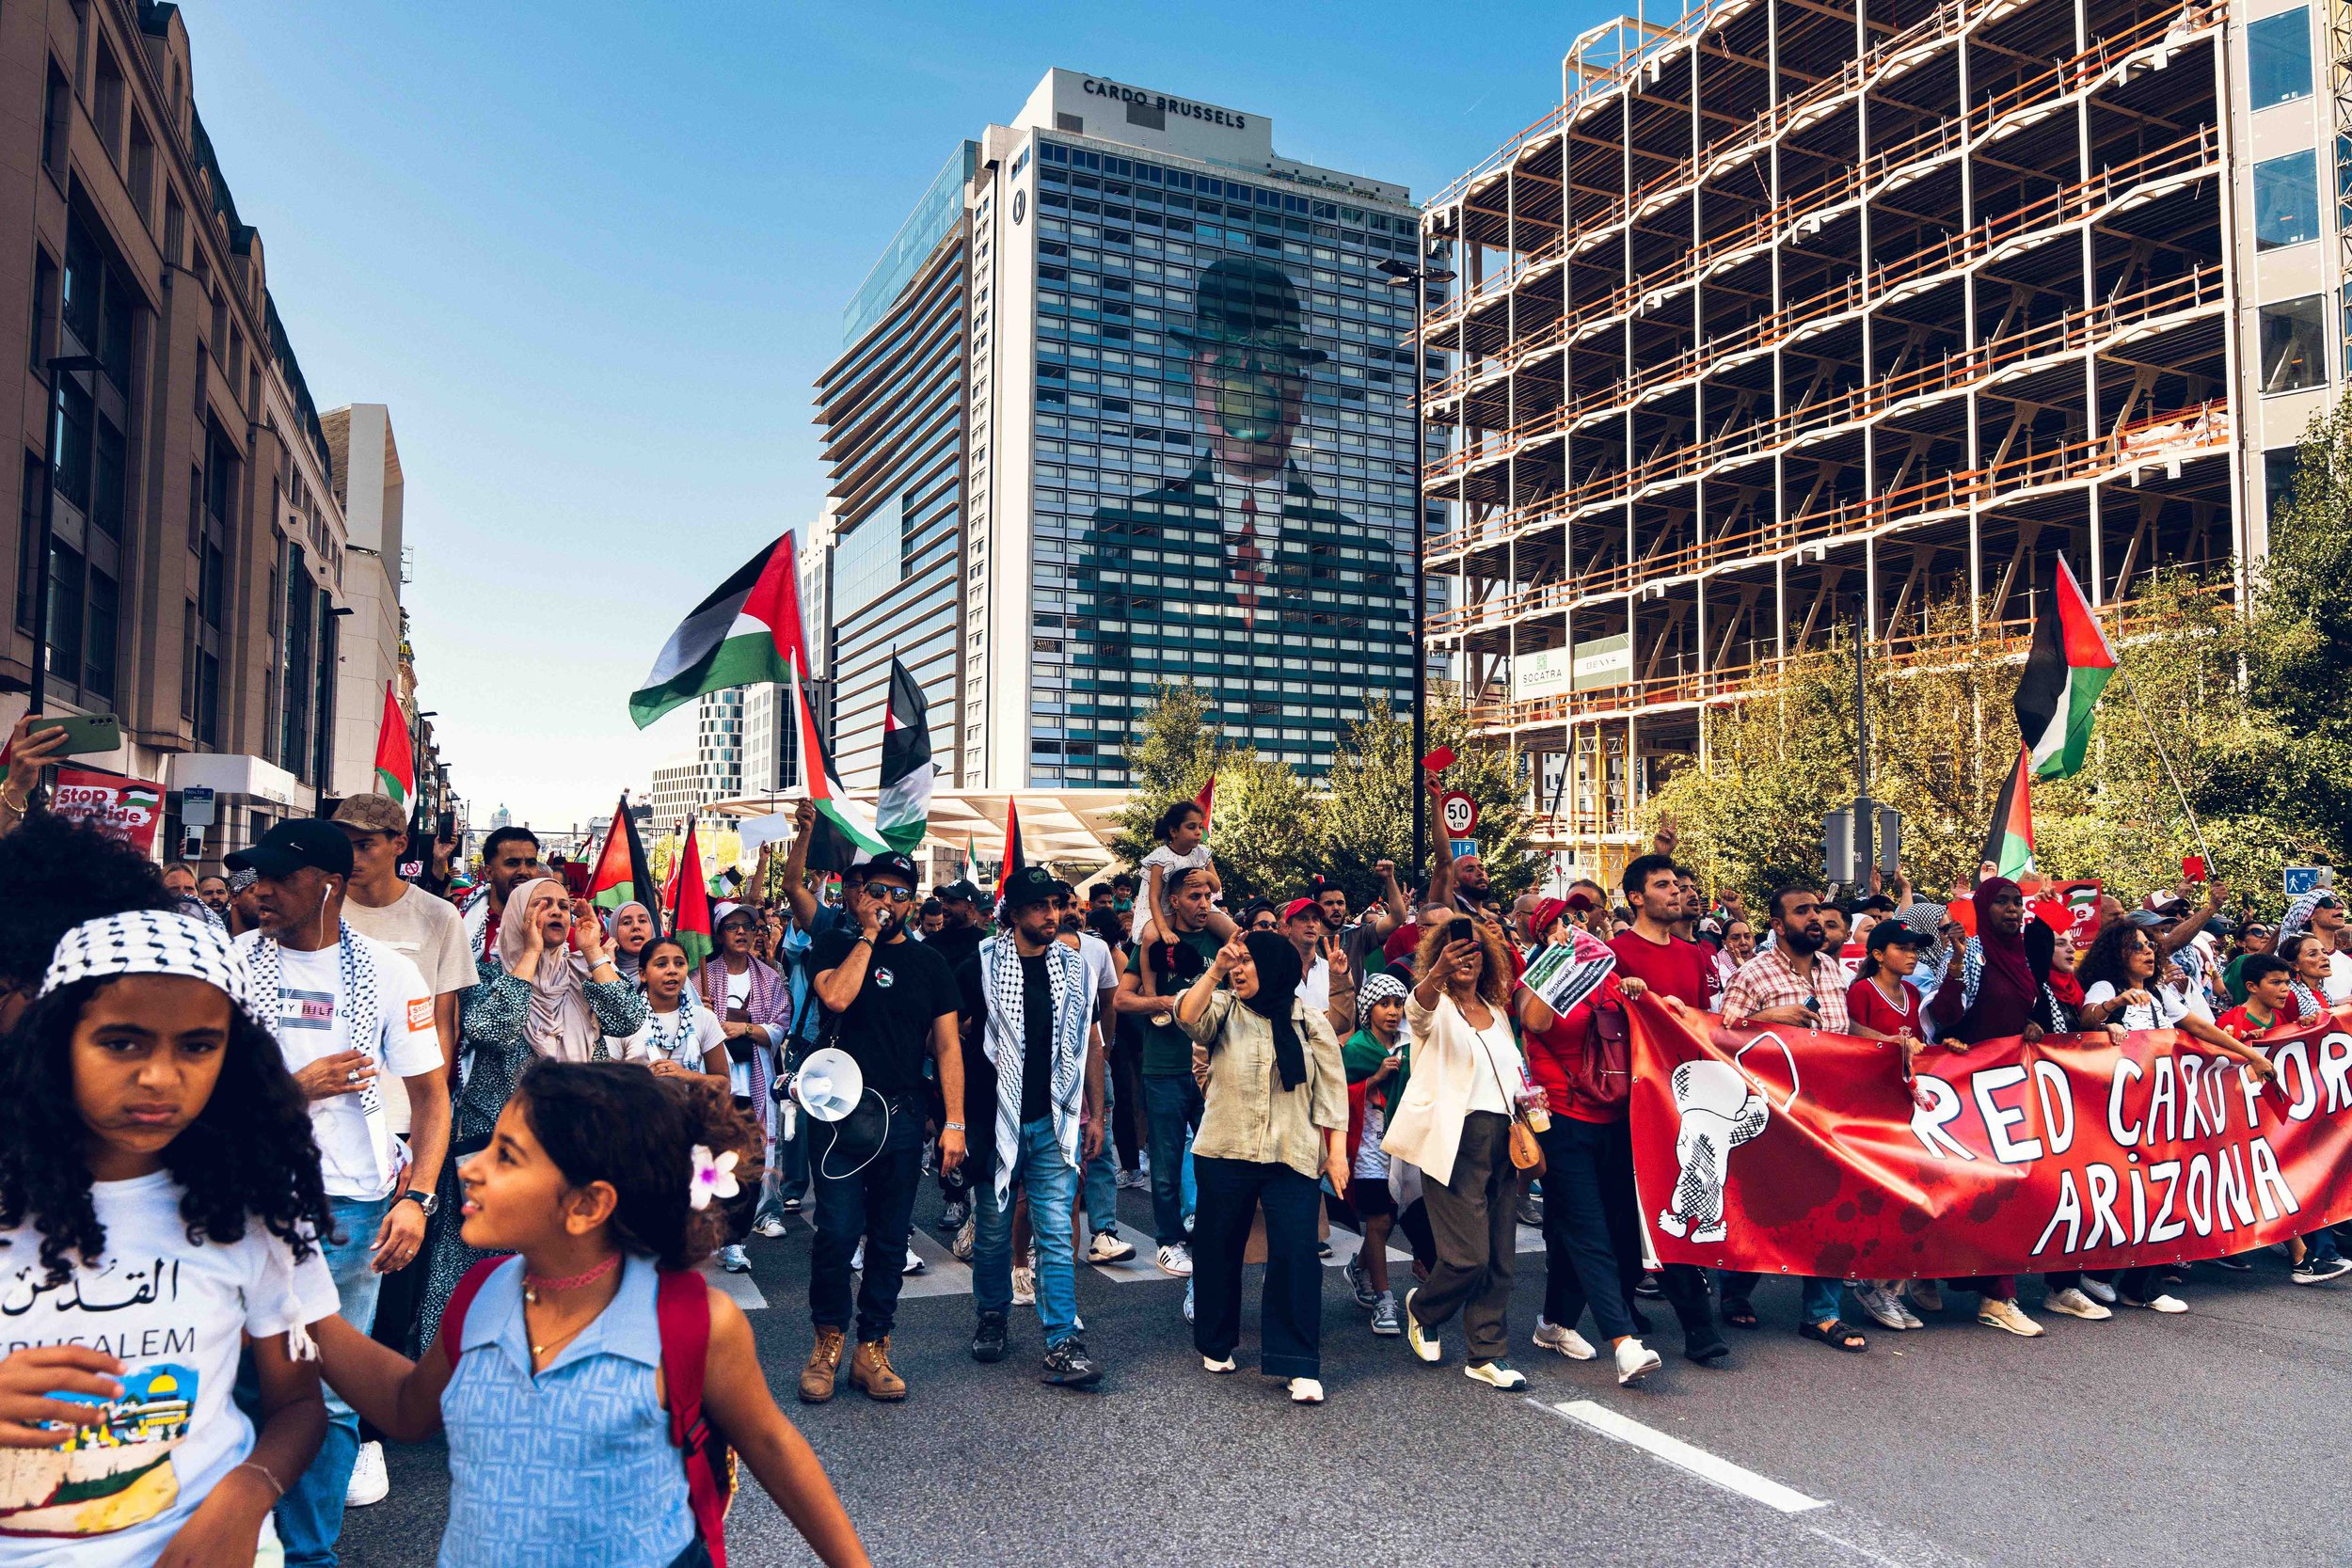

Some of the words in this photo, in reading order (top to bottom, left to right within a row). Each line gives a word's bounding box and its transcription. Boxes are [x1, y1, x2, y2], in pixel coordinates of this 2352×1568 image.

[1084, 79, 1147, 105] CARDO
[1157, 96, 1246, 129] BRUSSELS
[1523, 669, 1562, 684] SOCATRA
[59, 788, 107, 806] stop
[1448, 804, 1468, 819] 50
[1545, 968, 1572, 997] génocide
[1911, 1058, 2074, 1164] RED
[2238, 1031, 2352, 1131] FOR
